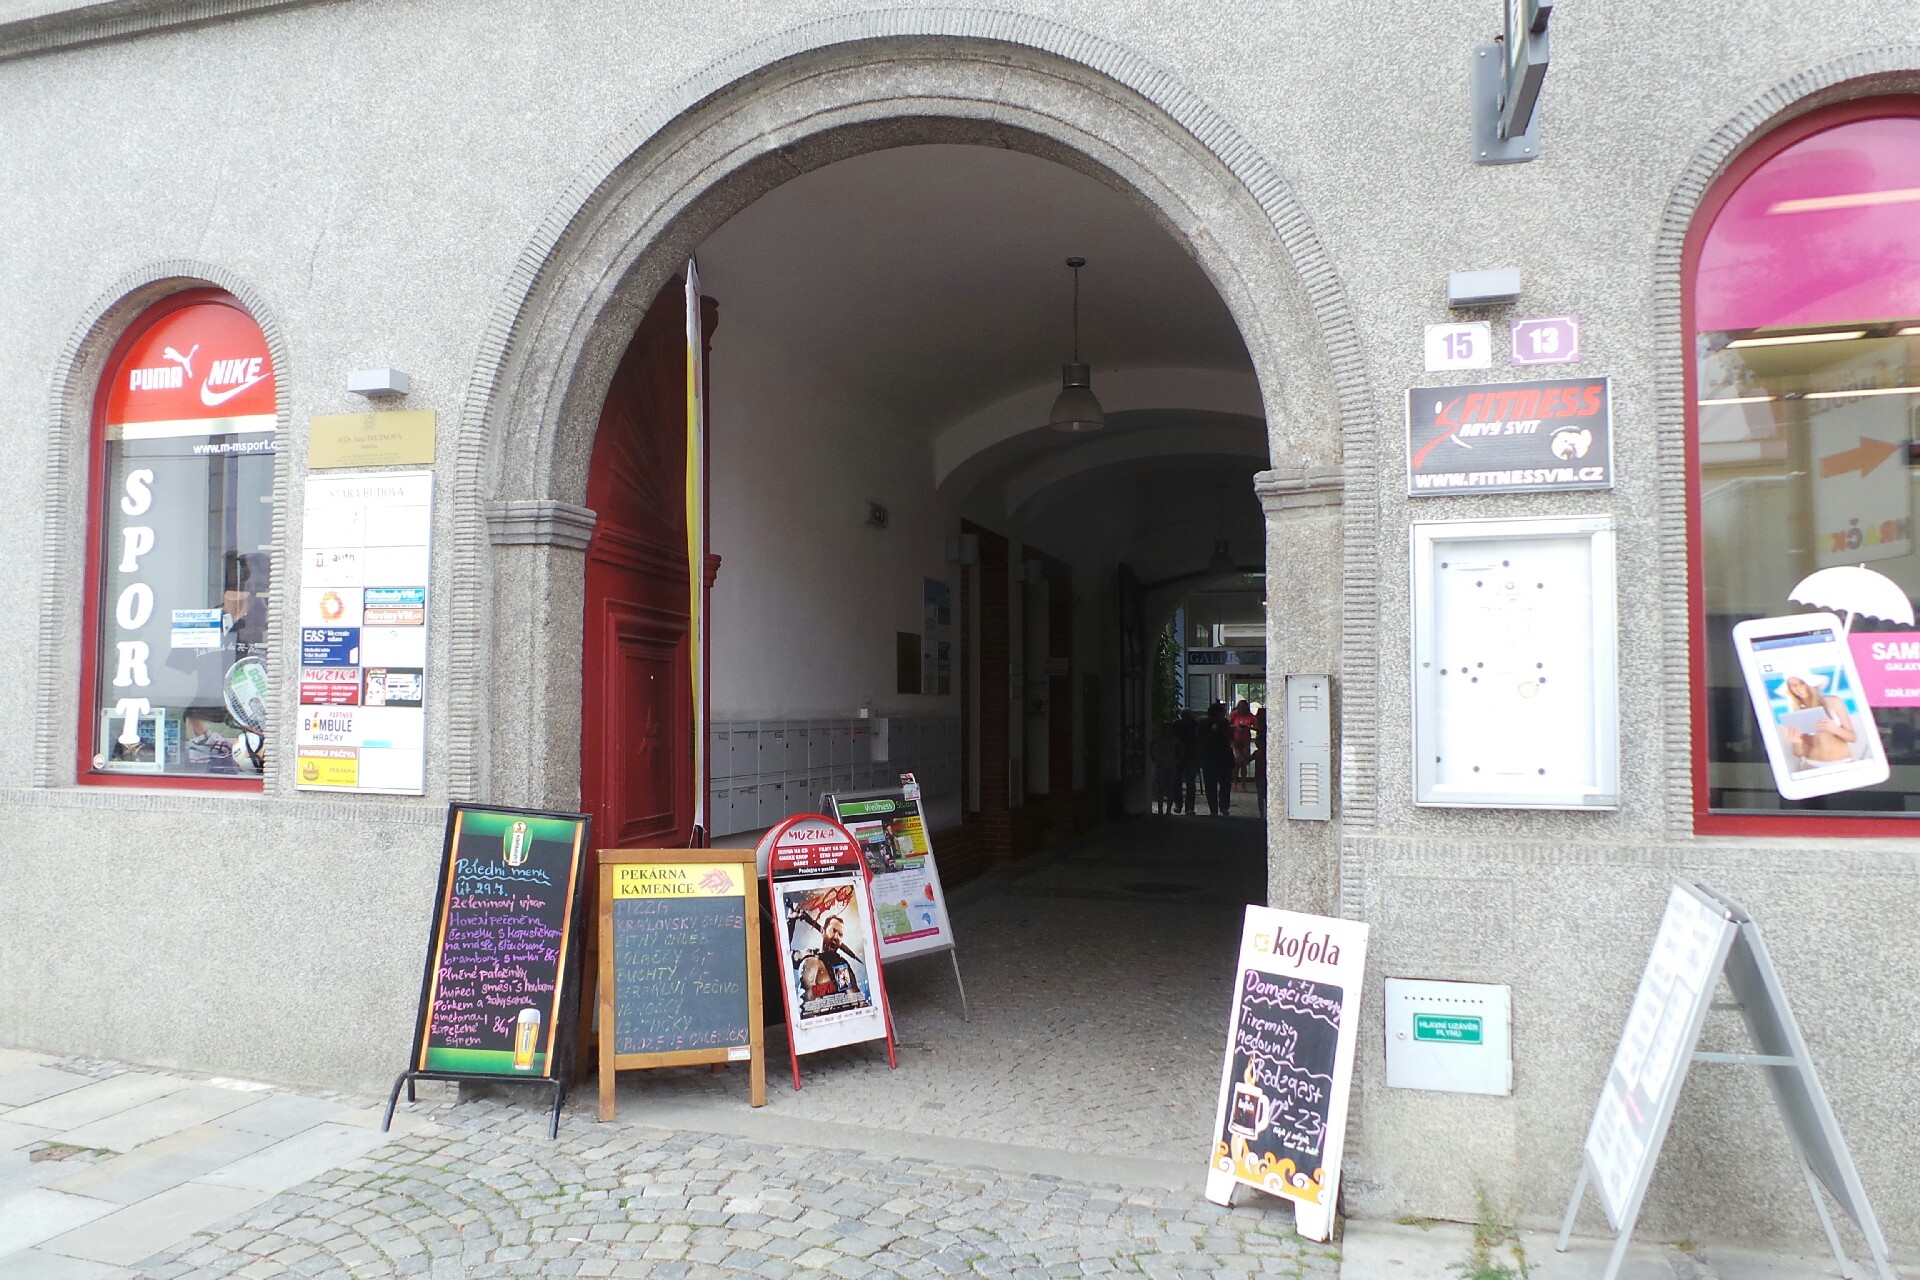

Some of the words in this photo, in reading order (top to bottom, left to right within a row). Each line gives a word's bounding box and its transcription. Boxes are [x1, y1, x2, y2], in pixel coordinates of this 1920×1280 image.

[1442, 331, 1473, 360] 15
[1529, 327, 1559, 354] 13
[129, 366, 184, 391] PUMA
[208, 357, 263, 386] NIKE
[1459, 384, 1604, 423] FITNESS
[1415, 467, 1604, 489] WWW.FITNESSVM.CZ
[112, 468, 155, 744] SPORT
[304, 669, 356, 681] MUZIKA
[787, 828, 836, 841] MUZIKA
[511, 867, 550, 880] menu
[621, 867, 687, 880] PEKÁRNA
[621, 883, 695, 895] KAMENICE
[444, 942, 460, 951] na
[1272, 926, 1341, 968] kofola
[693, 979, 740, 996] PEČIVO
[1253, 1057, 1324, 1104] Radegast
